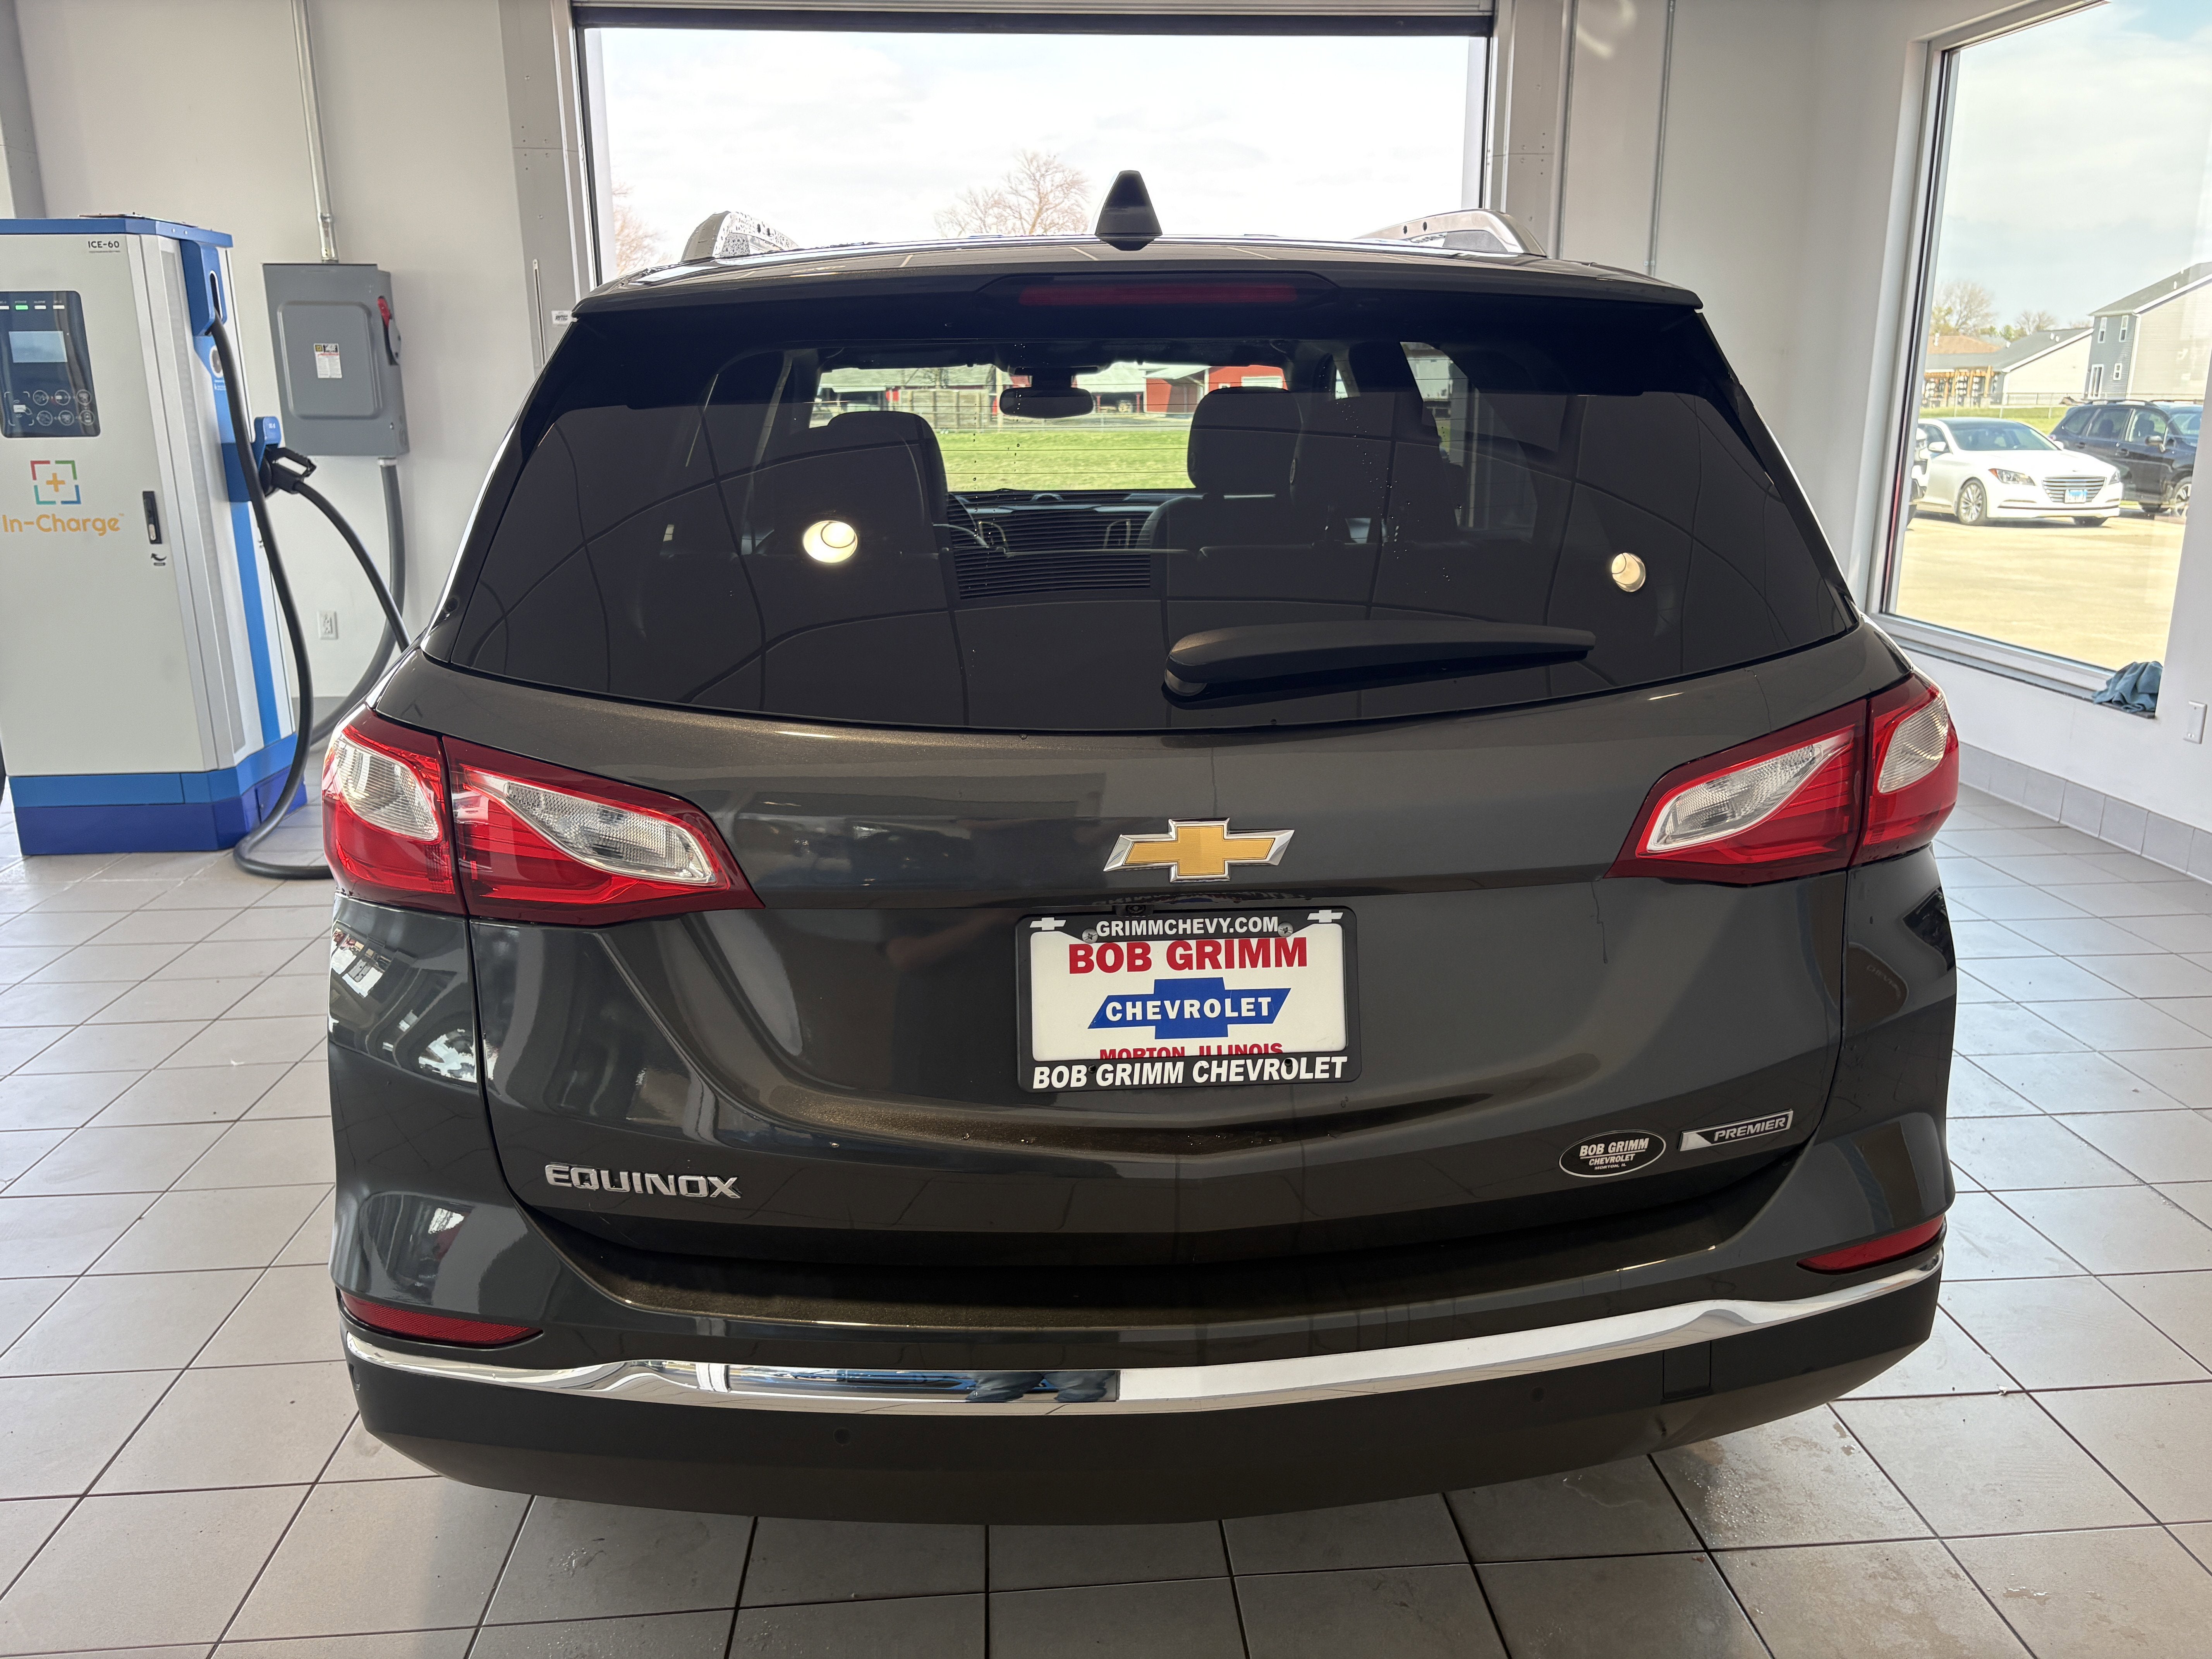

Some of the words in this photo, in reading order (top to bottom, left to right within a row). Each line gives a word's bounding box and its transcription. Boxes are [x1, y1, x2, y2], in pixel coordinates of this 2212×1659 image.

[1096, 916, 1278, 937] GRIMMCHEVY.COM
[1069, 942, 1152, 974] BOB
[1166, 937, 1307, 970] GRIMM
[1106, 997, 1272, 1022] CHEVROLET
[1033, 1065, 1087, 1089] BOB
[1096, 1061, 1184, 1086] GRIMM
[1193, 1056, 1348, 1084] CHEVROLET
[1714, 1117, 1786, 1141] PREMIER
[1579, 1144, 1605, 1157] BOB
[1608, 1138, 1649, 1154] GRIMM
[1589, 1154, 1635, 1166] CHEVROLET
[545, 1163, 741, 1199] EQUINOX
